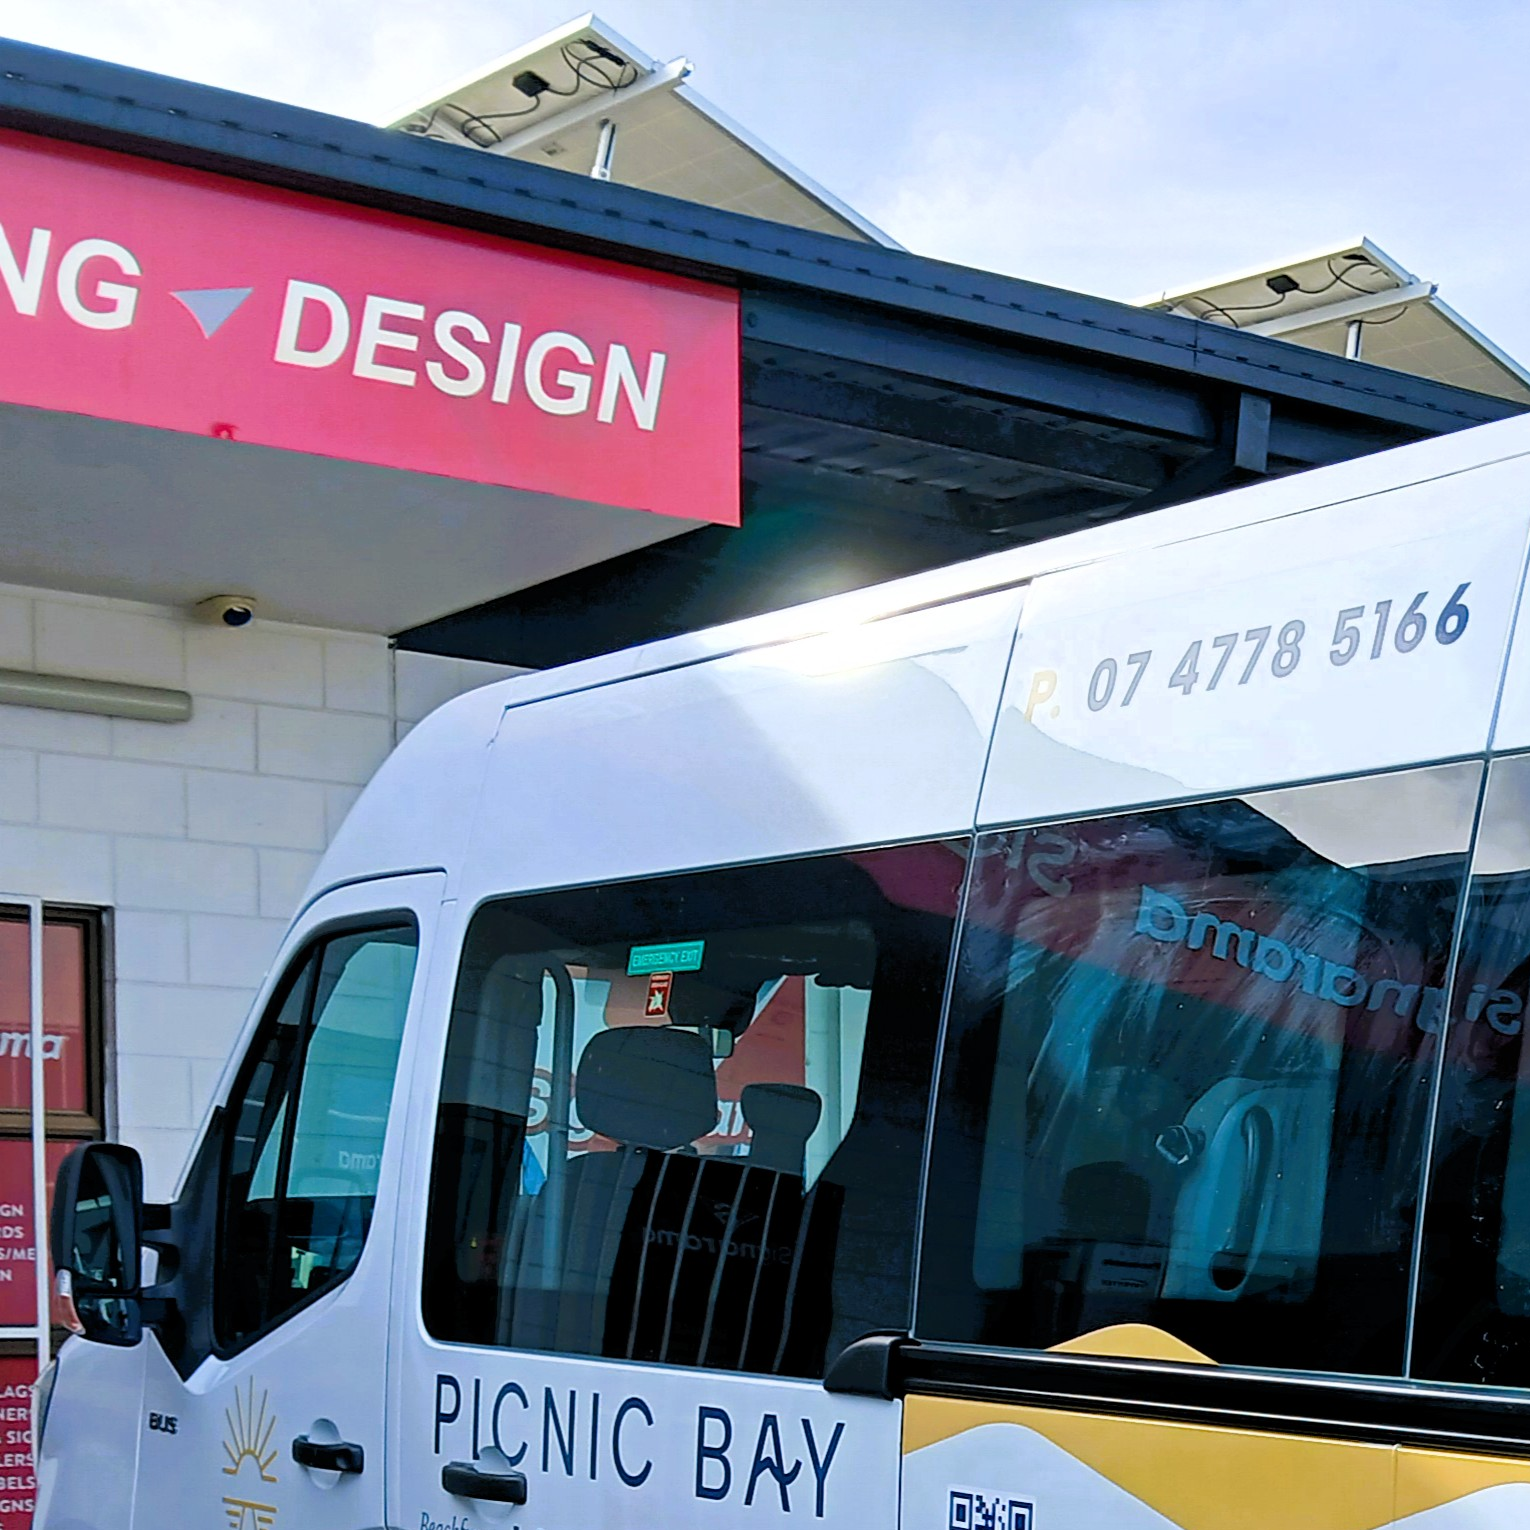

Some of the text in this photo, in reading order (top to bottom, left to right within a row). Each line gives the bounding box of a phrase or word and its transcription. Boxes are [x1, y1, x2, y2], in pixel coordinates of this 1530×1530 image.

[274, 278, 667, 431] DESIGN
[1087, 649, 1152, 713] 07
[1168, 619, 1306, 696] 4778
[1329, 581, 1472, 667] 5166
[0, 1225, 24, 1239] DS
[149, 1412, 179, 1435] BUS
[433, 1373, 846, 1518] PICNIC BAY
